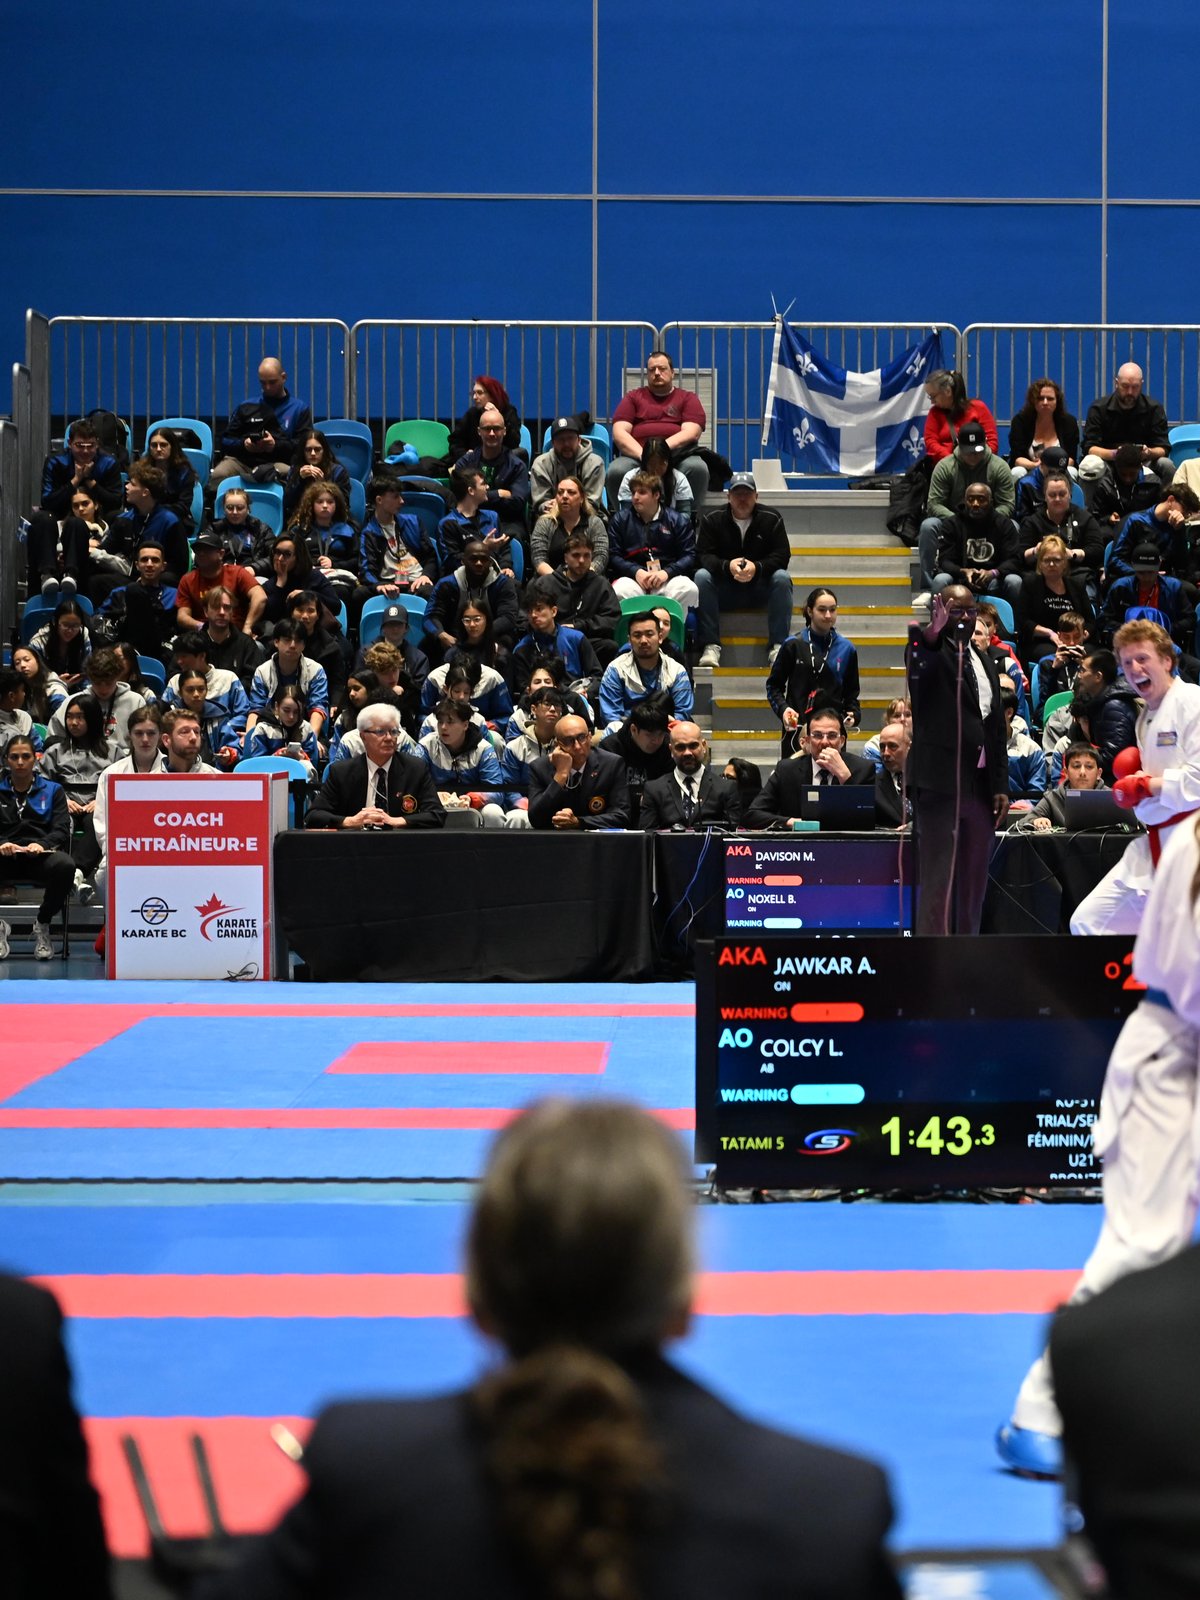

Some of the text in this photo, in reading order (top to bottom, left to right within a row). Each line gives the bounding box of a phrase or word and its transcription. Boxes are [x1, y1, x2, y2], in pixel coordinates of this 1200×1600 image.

[153, 812, 224, 827] COACH
[726, 845, 752, 856] AKA
[755, 851, 816, 862] DAVISON M.
[727, 877, 763, 885] WARNING
[726, 888, 744, 899] AO
[748, 894, 796, 904] NOXELL B.
[217, 918, 257, 928] KARATE
[121, 929, 187, 938] KARATE BC
[217, 929, 258, 938] CANADA
[718, 946, 767, 966] AKA
[773, 956, 876, 975] JAWKAR A.
[773, 981, 792, 992] ON
[720, 1007, 788, 1020] WARNING
[718, 1028, 754, 1049] AO
[760, 1038, 843, 1057] COLCY L.
[760, 1063, 775, 1074] AB
[720, 1088, 789, 1102] WARNING
[720, 1137, 784, 1151] TATAMI 5
[1068, 1153, 1094, 1168] U21
